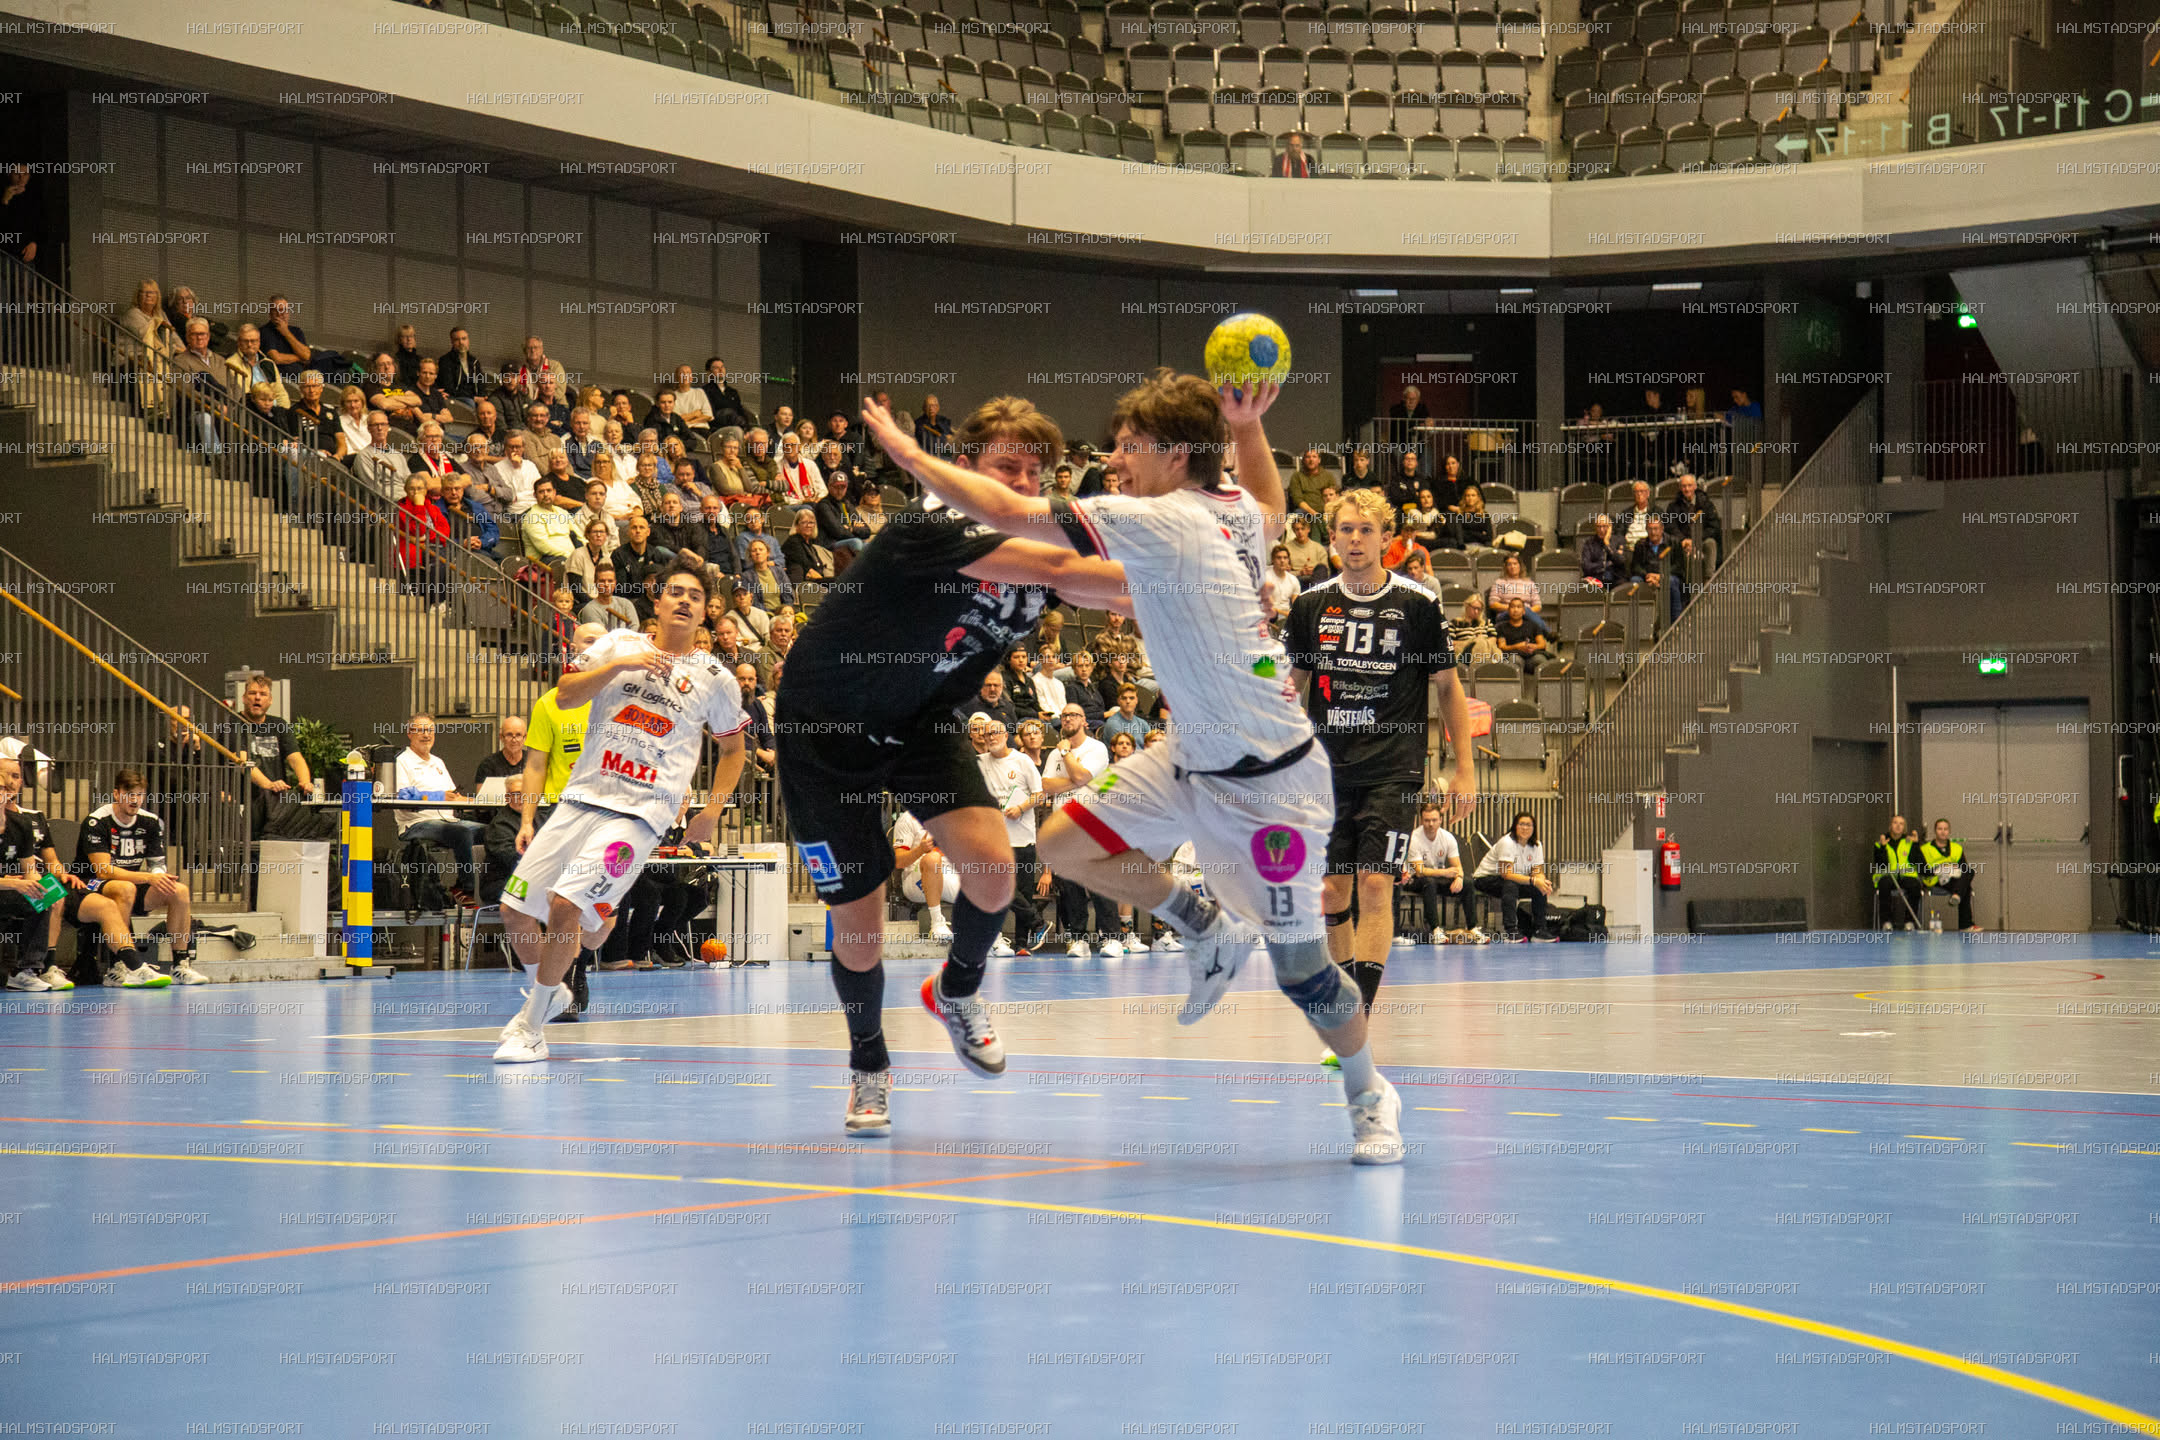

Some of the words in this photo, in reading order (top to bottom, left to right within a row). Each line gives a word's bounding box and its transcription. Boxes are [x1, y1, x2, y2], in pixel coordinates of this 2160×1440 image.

[1345, 621, 1374, 655] 13
[1337, 658, 1396, 670] TOTALBYGGEN
[601, 750, 658, 783] MAXI
[1056, 763, 1061, 771] A
[120, 838, 135, 857] 18
[1384, 830, 1409, 865] 13
[1266, 886, 1294, 917] 13
